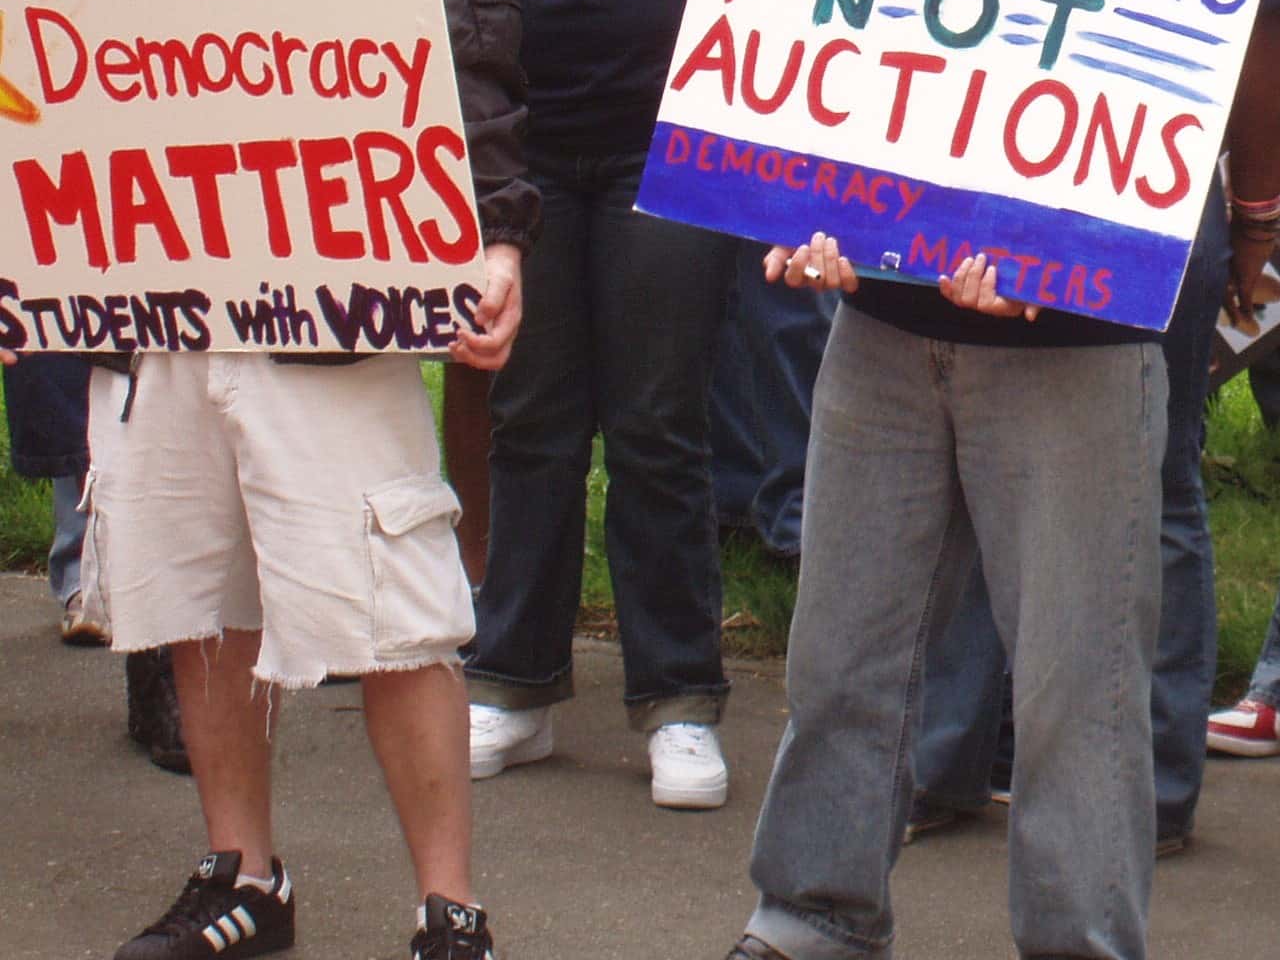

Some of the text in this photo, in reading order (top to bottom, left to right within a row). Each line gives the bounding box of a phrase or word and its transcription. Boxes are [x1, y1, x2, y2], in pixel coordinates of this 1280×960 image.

[25, 7, 431, 127] Democracy
[671, 14, 1205, 209] AUCTIONS
[13, 126, 480, 272] MATTERS
[665, 129, 925, 221] DEMOCRACY
[226, 282, 319, 348] with
[316, 282, 487, 350] VOICES
